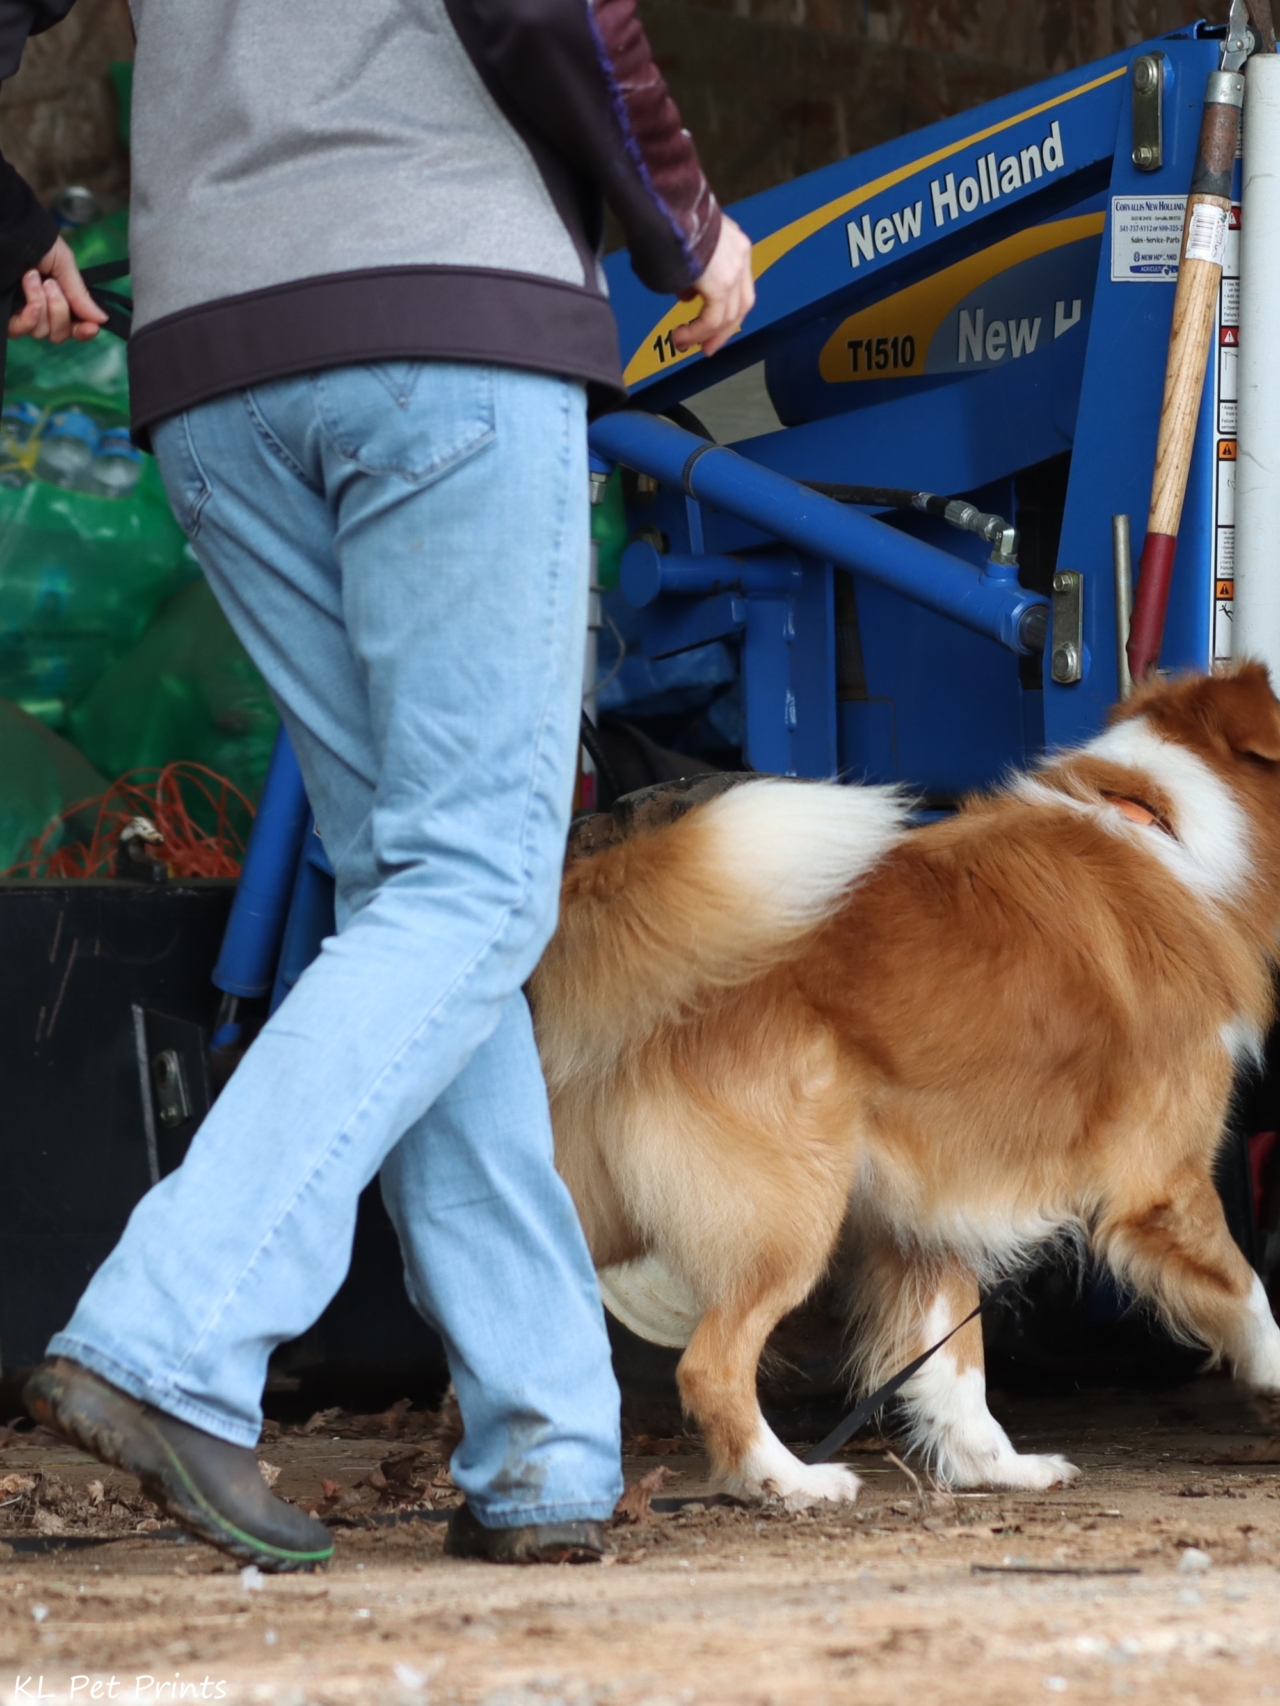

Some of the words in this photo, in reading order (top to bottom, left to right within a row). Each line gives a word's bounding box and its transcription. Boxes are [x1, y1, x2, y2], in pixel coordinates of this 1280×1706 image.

[847, 201, 922, 268] New
[930, 120, 1064, 228] Holland
[1146, 202, 1157, 211] NEW
[846, 333, 916, 372] T1510
[958, 308, 1042, 363] New
